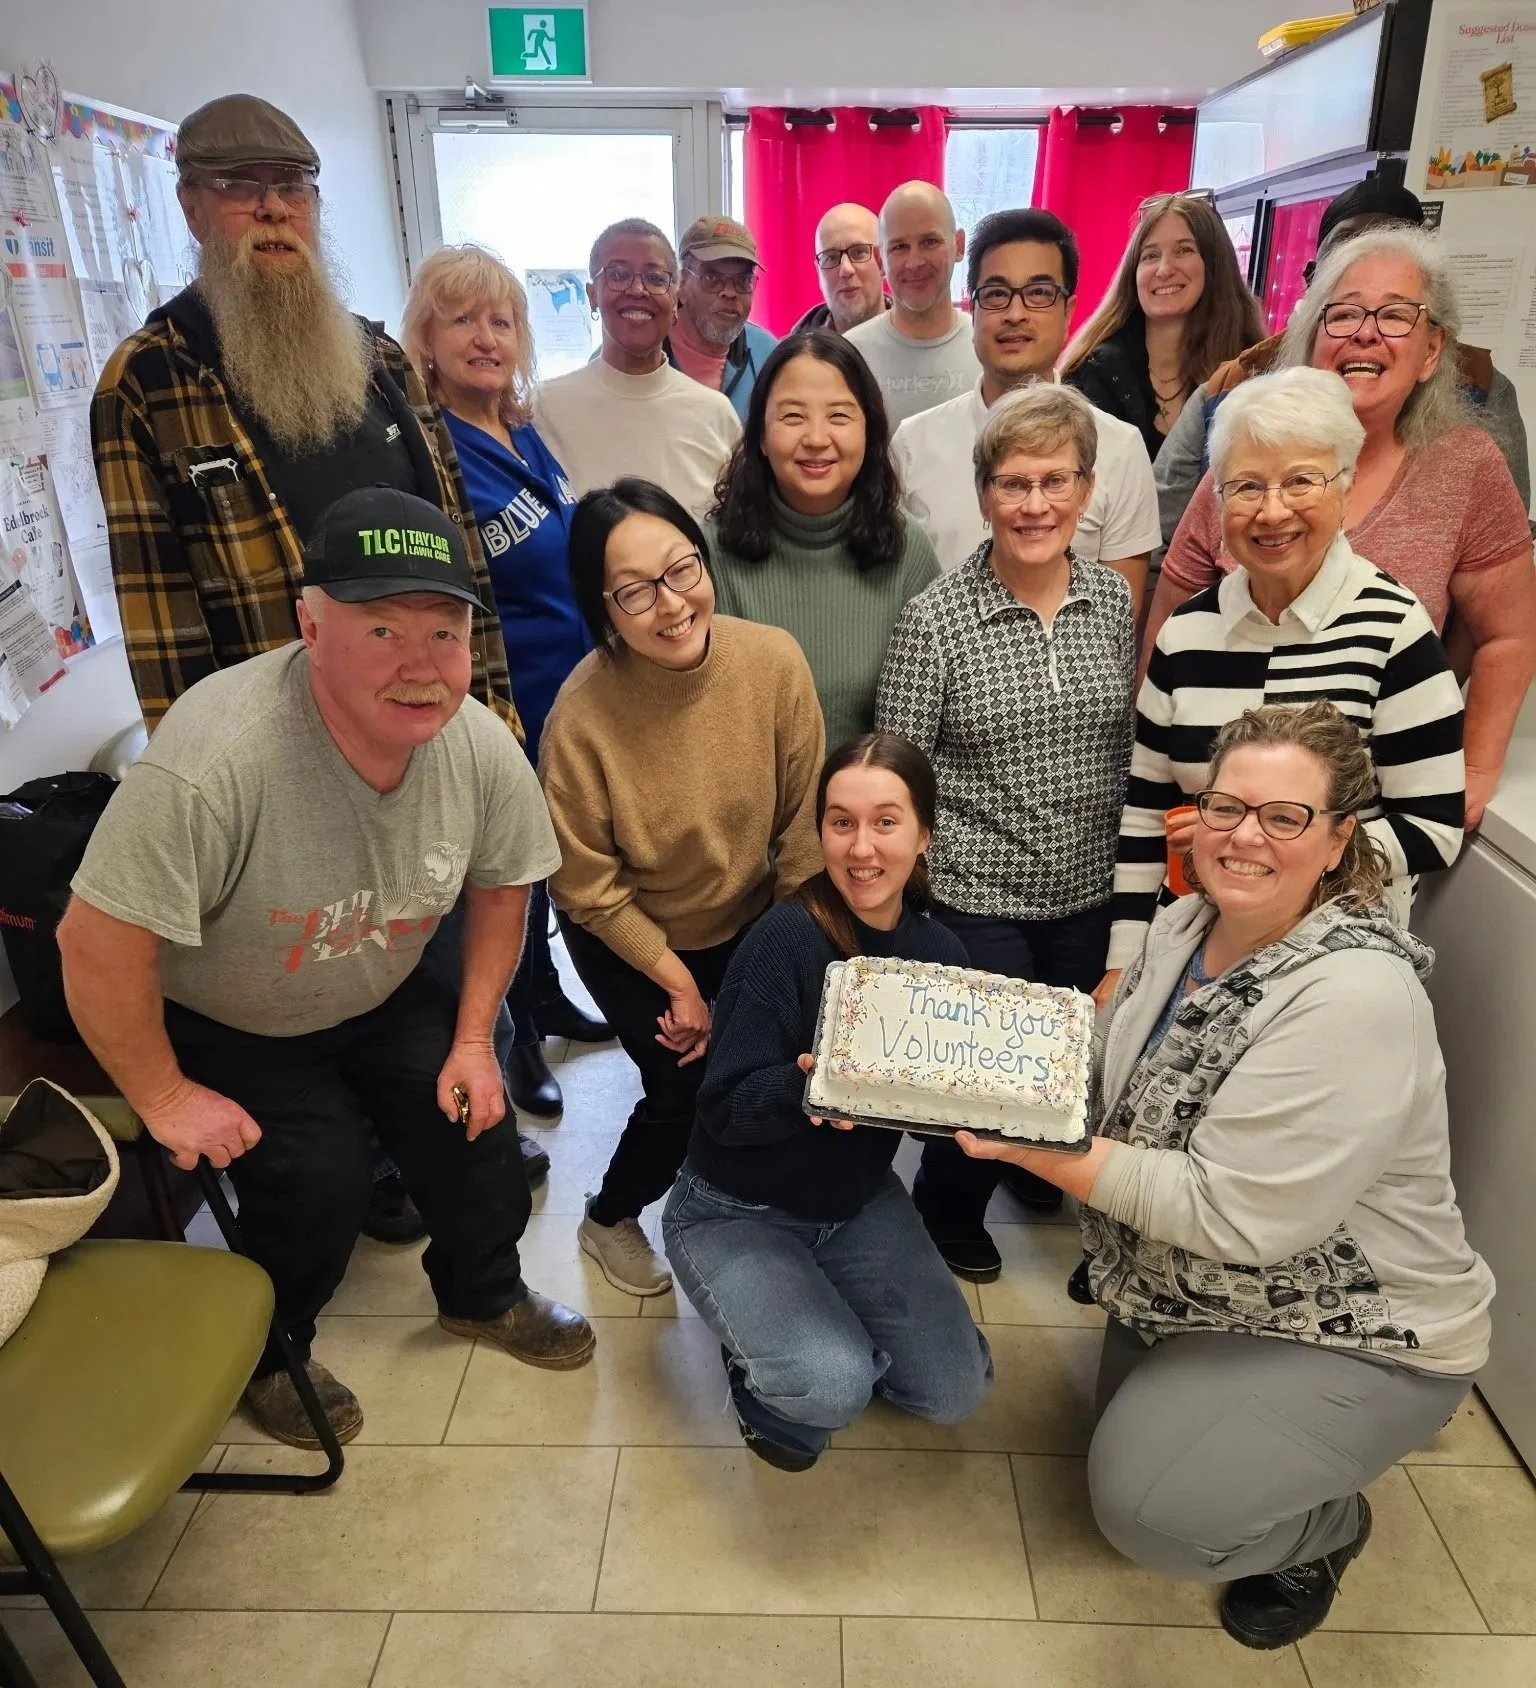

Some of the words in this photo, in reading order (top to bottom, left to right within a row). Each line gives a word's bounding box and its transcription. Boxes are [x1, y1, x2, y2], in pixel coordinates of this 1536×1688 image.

[1458, 22, 1510, 36] Suggested
[3, 503, 50, 533] Edelbrock
[480, 487, 550, 558] BLUE
[21, 525, 43, 544] Cafe
[358, 528, 401, 556] TLC
[406, 529, 449, 553] TAYLOR
[409, 545, 433, 559] LAWN
[434, 550, 451, 564] CARE
[903, 984, 990, 1028] Thank
[1000, 1007, 1056, 1049] you
[880, 1015, 1049, 1082] Volunteers
